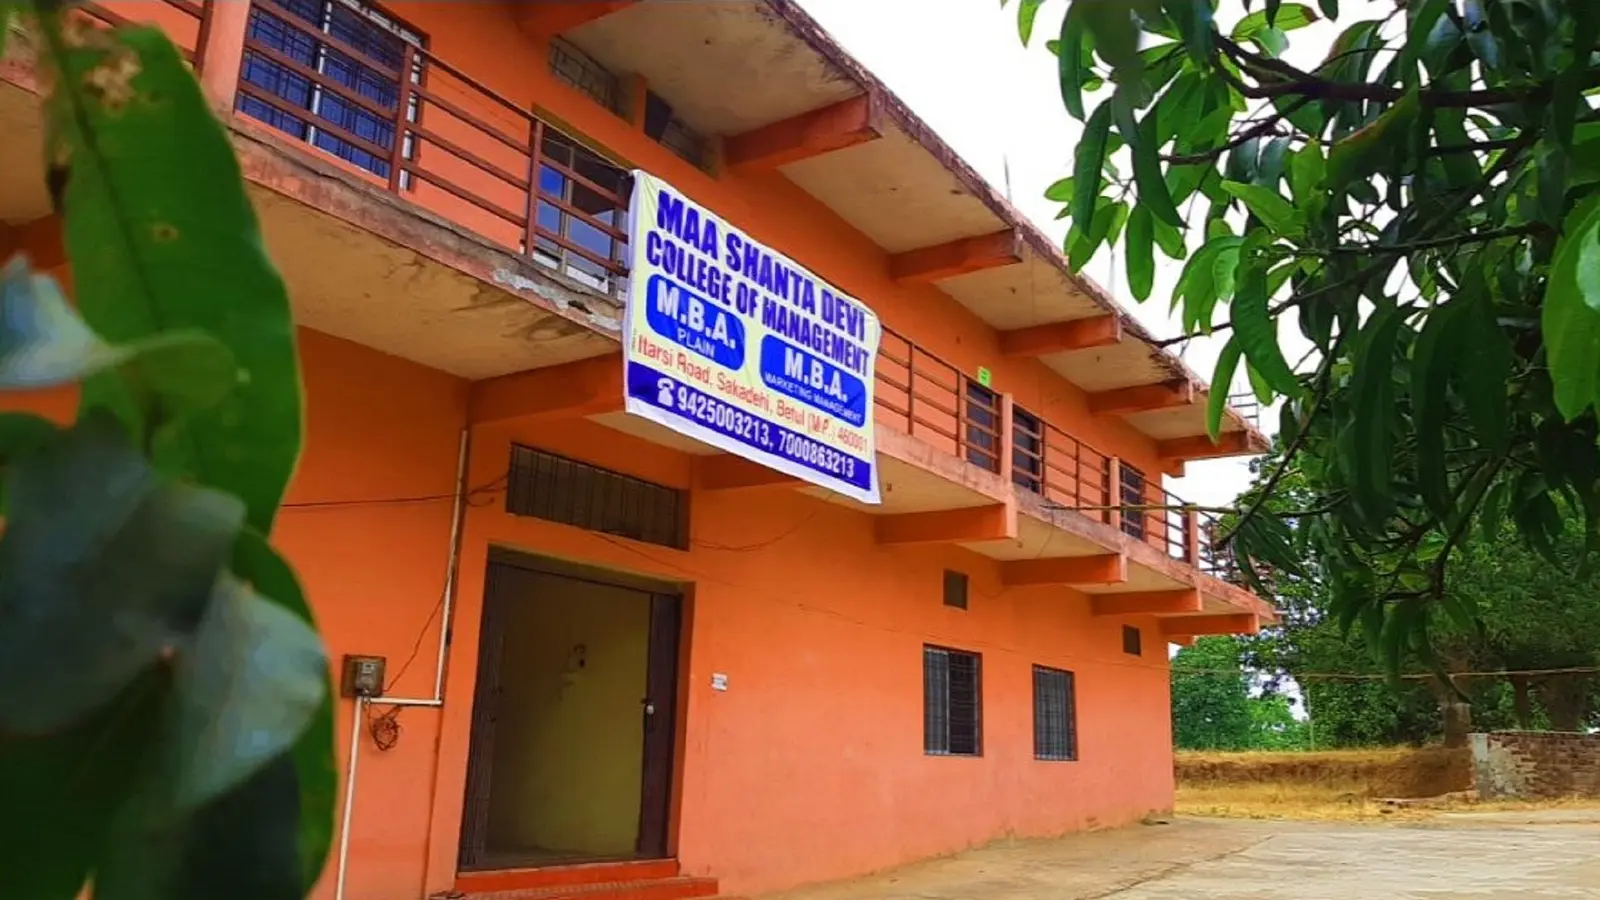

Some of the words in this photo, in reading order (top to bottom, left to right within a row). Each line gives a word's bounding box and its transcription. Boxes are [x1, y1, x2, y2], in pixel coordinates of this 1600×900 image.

[646, 230, 732, 306] COLLEGE
[736, 282, 759, 318] OF
[762, 296, 870, 377] MANAGEMENT
[657, 189, 719, 260] MAA
[726, 232, 816, 315] SHANTA
[821, 289, 865, 341] DEVI
[656, 279, 737, 350] M.B.A.
[677, 327, 715, 358] PLAIN
[638, 335, 673, 365] Itarsi
[677, 352, 713, 385] Road,
[776, 399, 806, 428] Betul
[765, 373, 813, 401] MARKETING
[814, 393, 862, 424] MANAGEMENT
[784, 348, 848, 403] M.B.A.
[677, 386, 775, 448] 9425003213,
[778, 430, 855, 478] 7000863213
